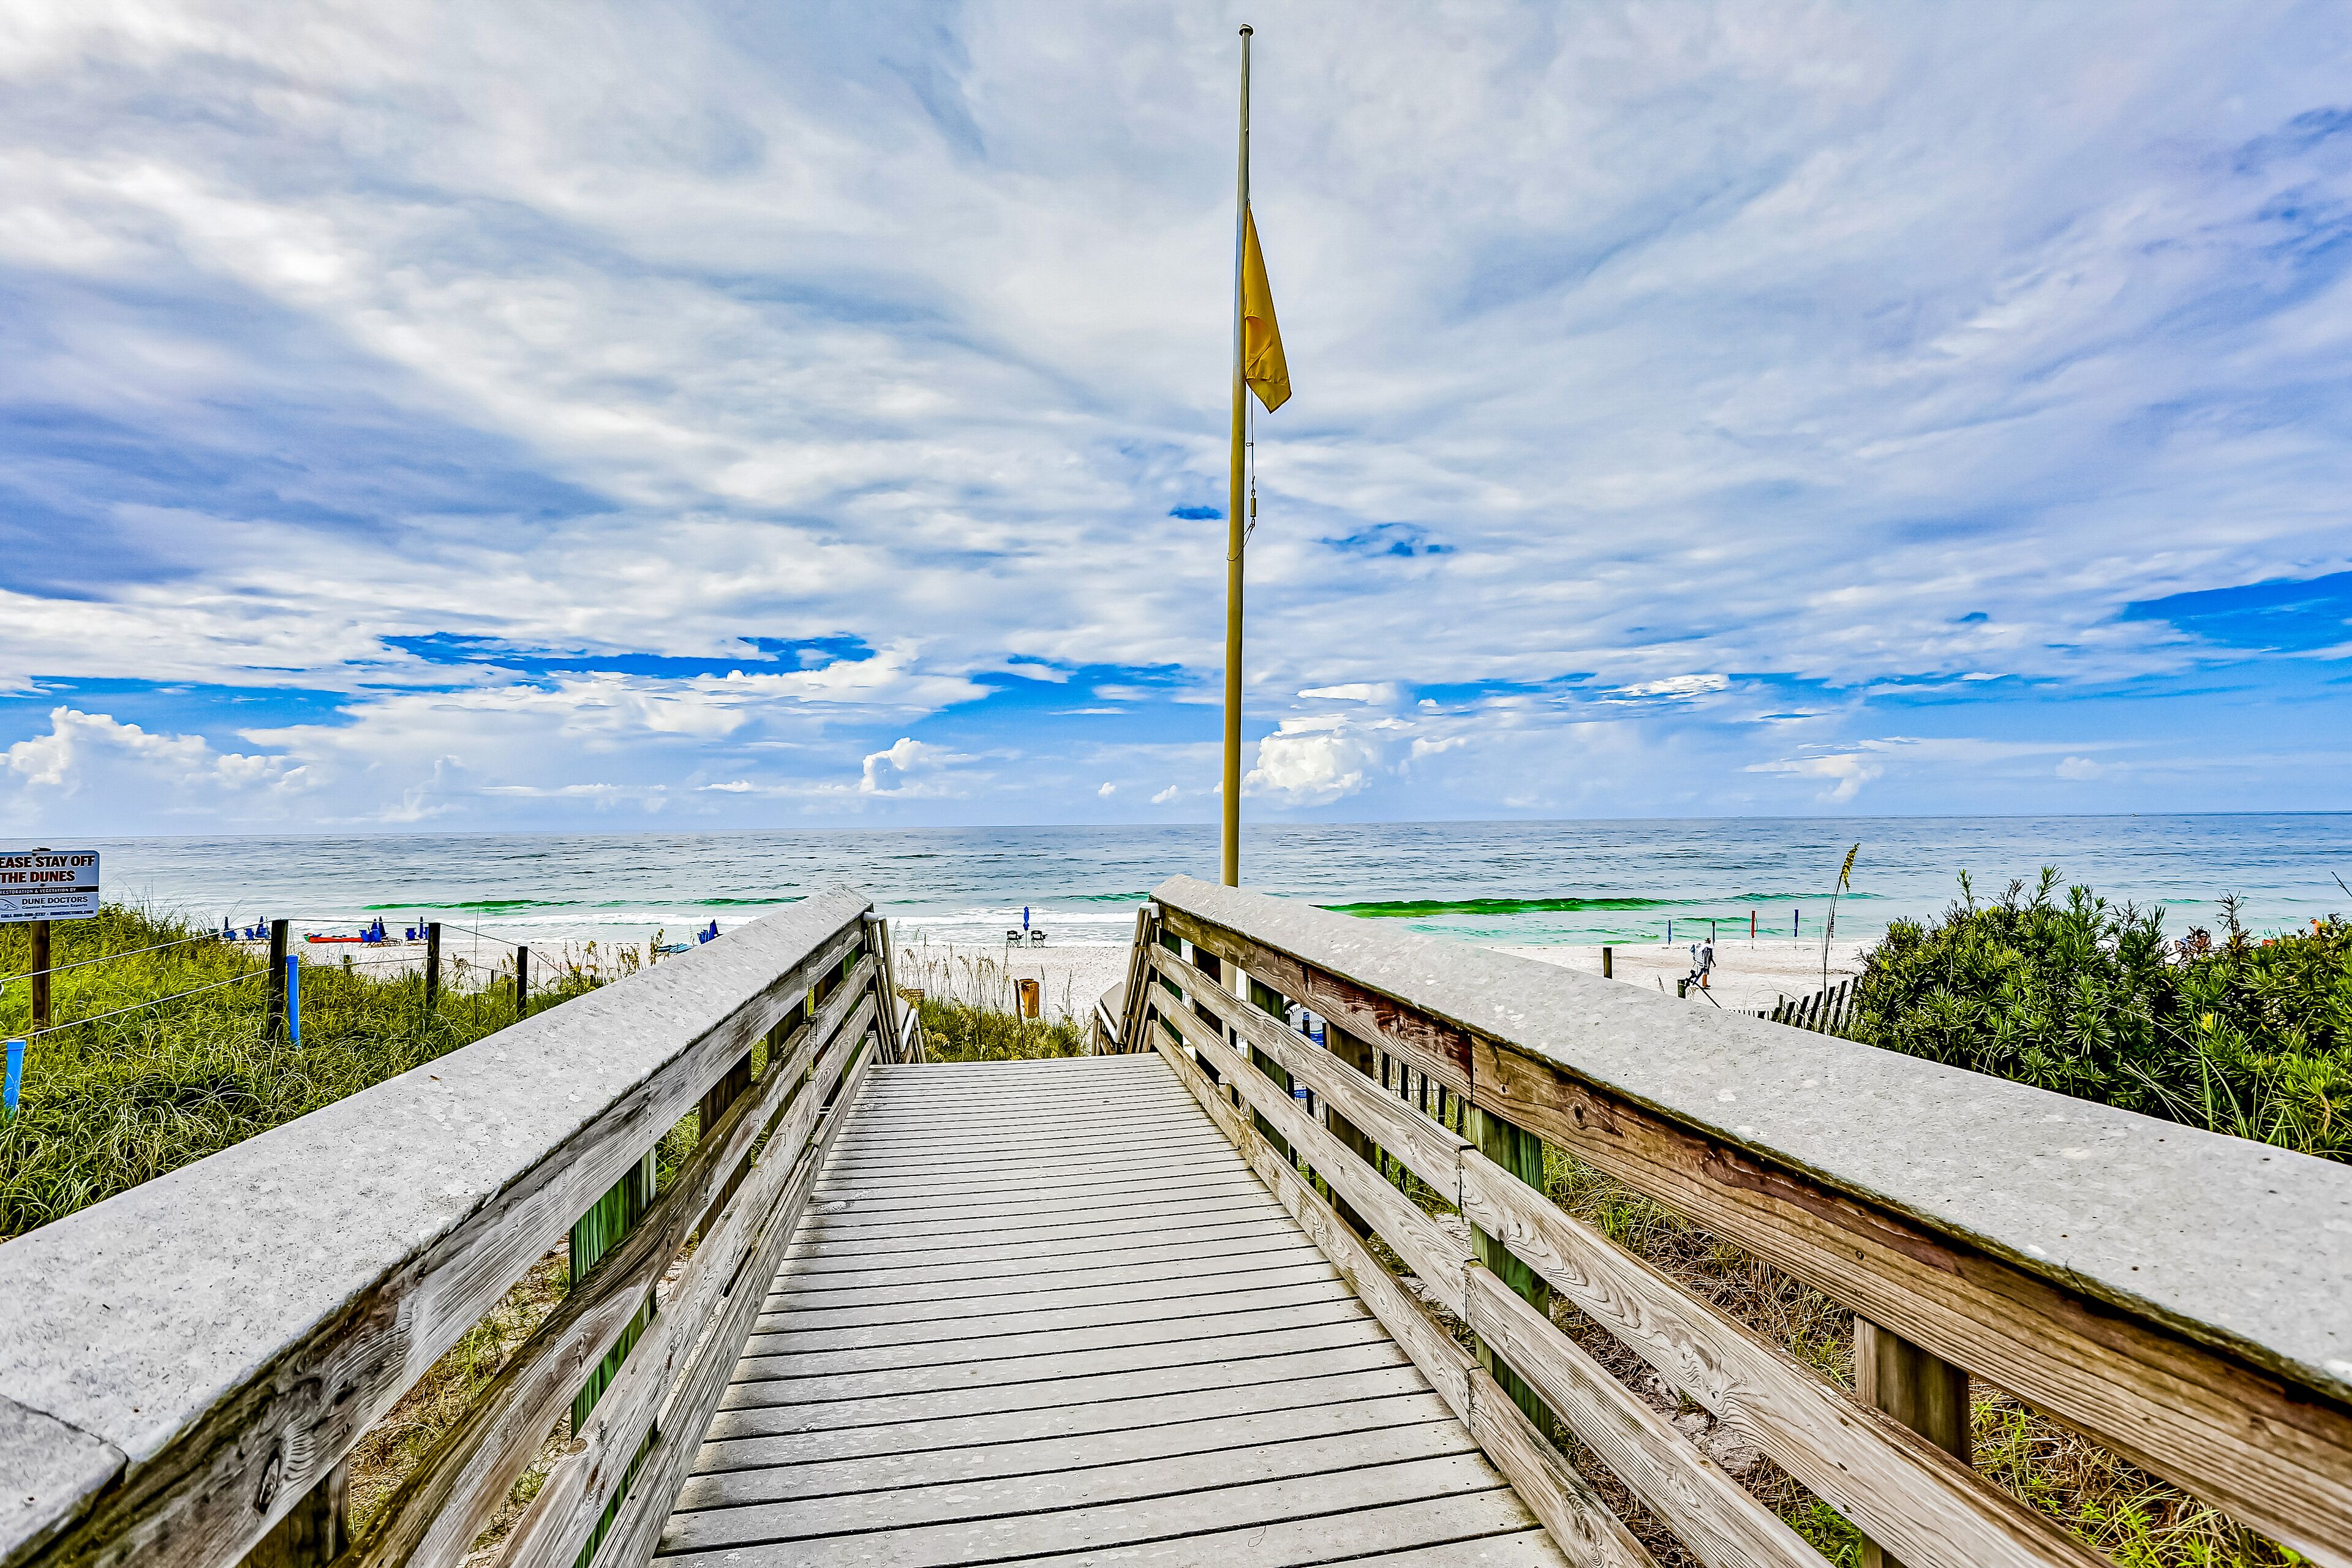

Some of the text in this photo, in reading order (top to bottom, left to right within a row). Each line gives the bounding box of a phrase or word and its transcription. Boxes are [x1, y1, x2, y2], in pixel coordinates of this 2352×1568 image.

[35, 856, 68, 868] STAY
[70, 855, 96, 867] OFF
[0, 870, 75, 883] THE DUNES
